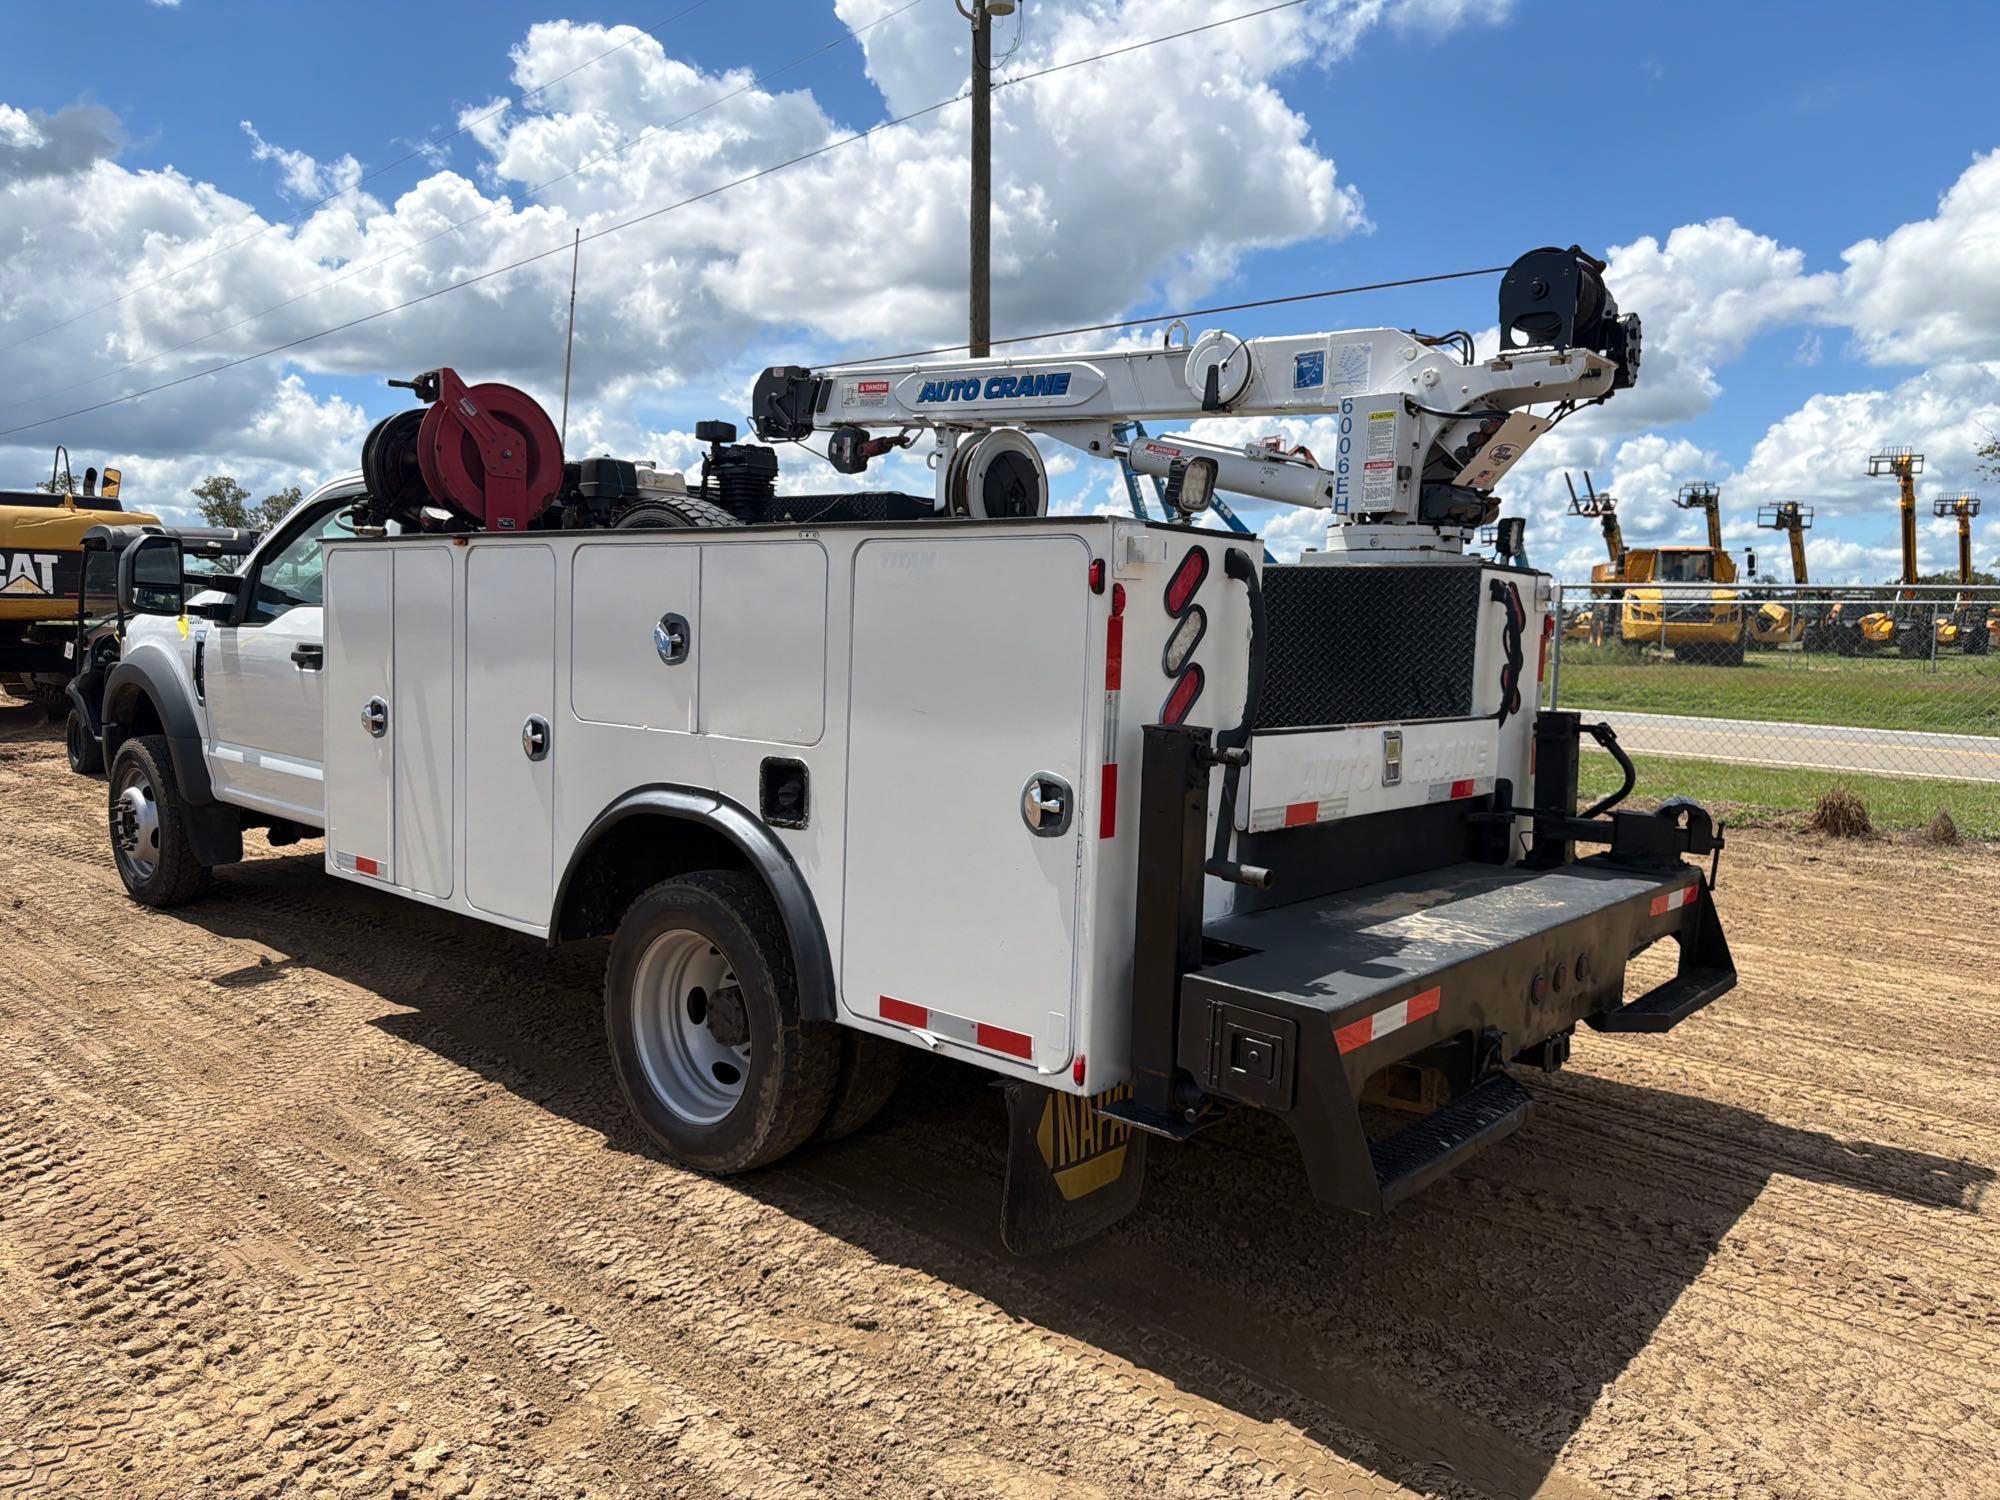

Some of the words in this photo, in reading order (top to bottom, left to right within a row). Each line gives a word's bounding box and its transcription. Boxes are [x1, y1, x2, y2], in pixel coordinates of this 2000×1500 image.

[865, 383, 888, 392] DANGER
[916, 379, 981, 403] AUTO
[983, 372, 1072, 399] CRANE
[1154, 447, 1179, 456] DANGER
[1334, 398, 1354, 514] 6006EH
[1295, 752, 1376, 799] AUTO
[1406, 739, 1489, 784] CRANE
